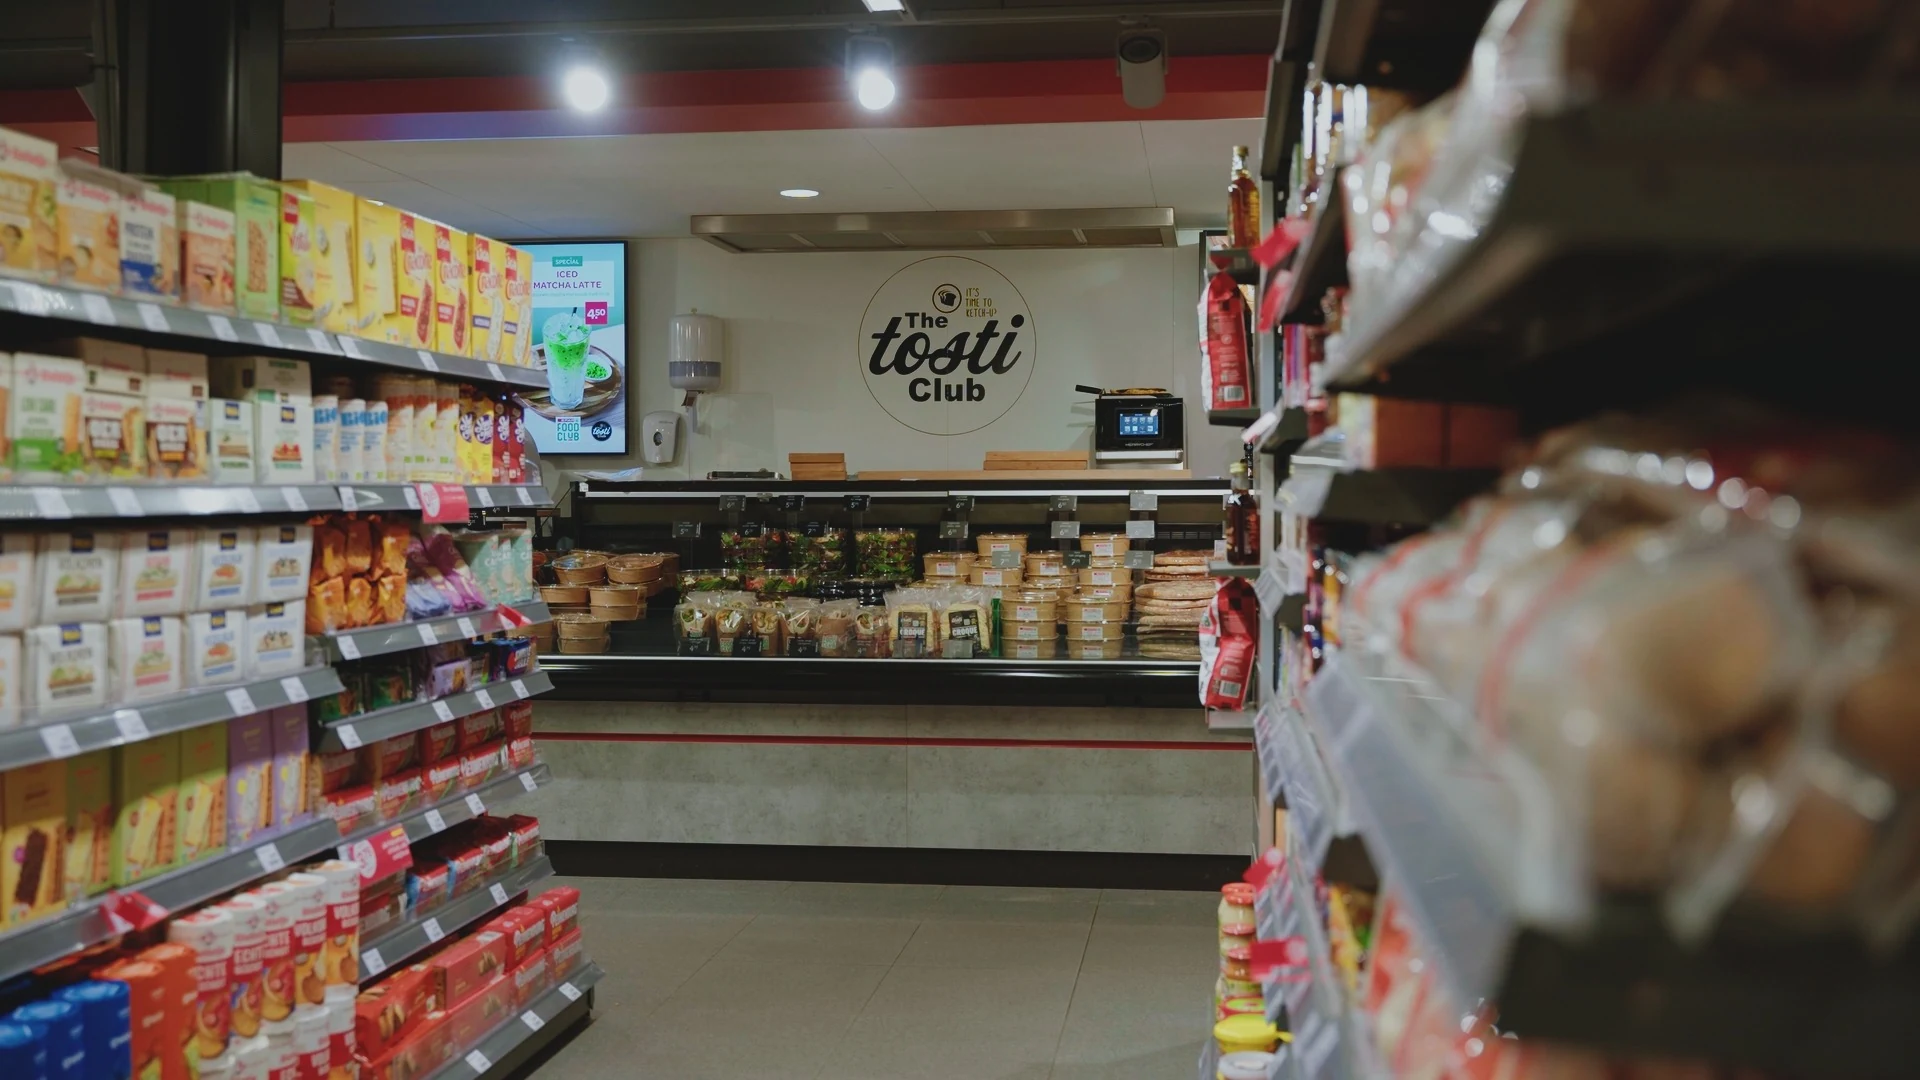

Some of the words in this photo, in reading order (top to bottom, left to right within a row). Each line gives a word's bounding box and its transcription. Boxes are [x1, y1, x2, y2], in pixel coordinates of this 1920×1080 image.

[555, 257, 580, 265] SPECIAL
[556, 270, 578, 278] ICED
[533, 281, 571, 289] MATCHA
[573, 281, 602, 289] LATTE
[966, 287, 980, 297] IT'S
[965, 298, 979, 307] TIME
[983, 298, 992, 307] TO
[904, 312, 949, 329] The
[868, 313, 1025, 376] tosti
[908, 377, 986, 403] Club
[557, 422, 580, 432] FOOD
[557, 432, 580, 441] CLUB
[899, 628, 925, 636] CROQUE
[952, 626, 978, 637] CROQUE
